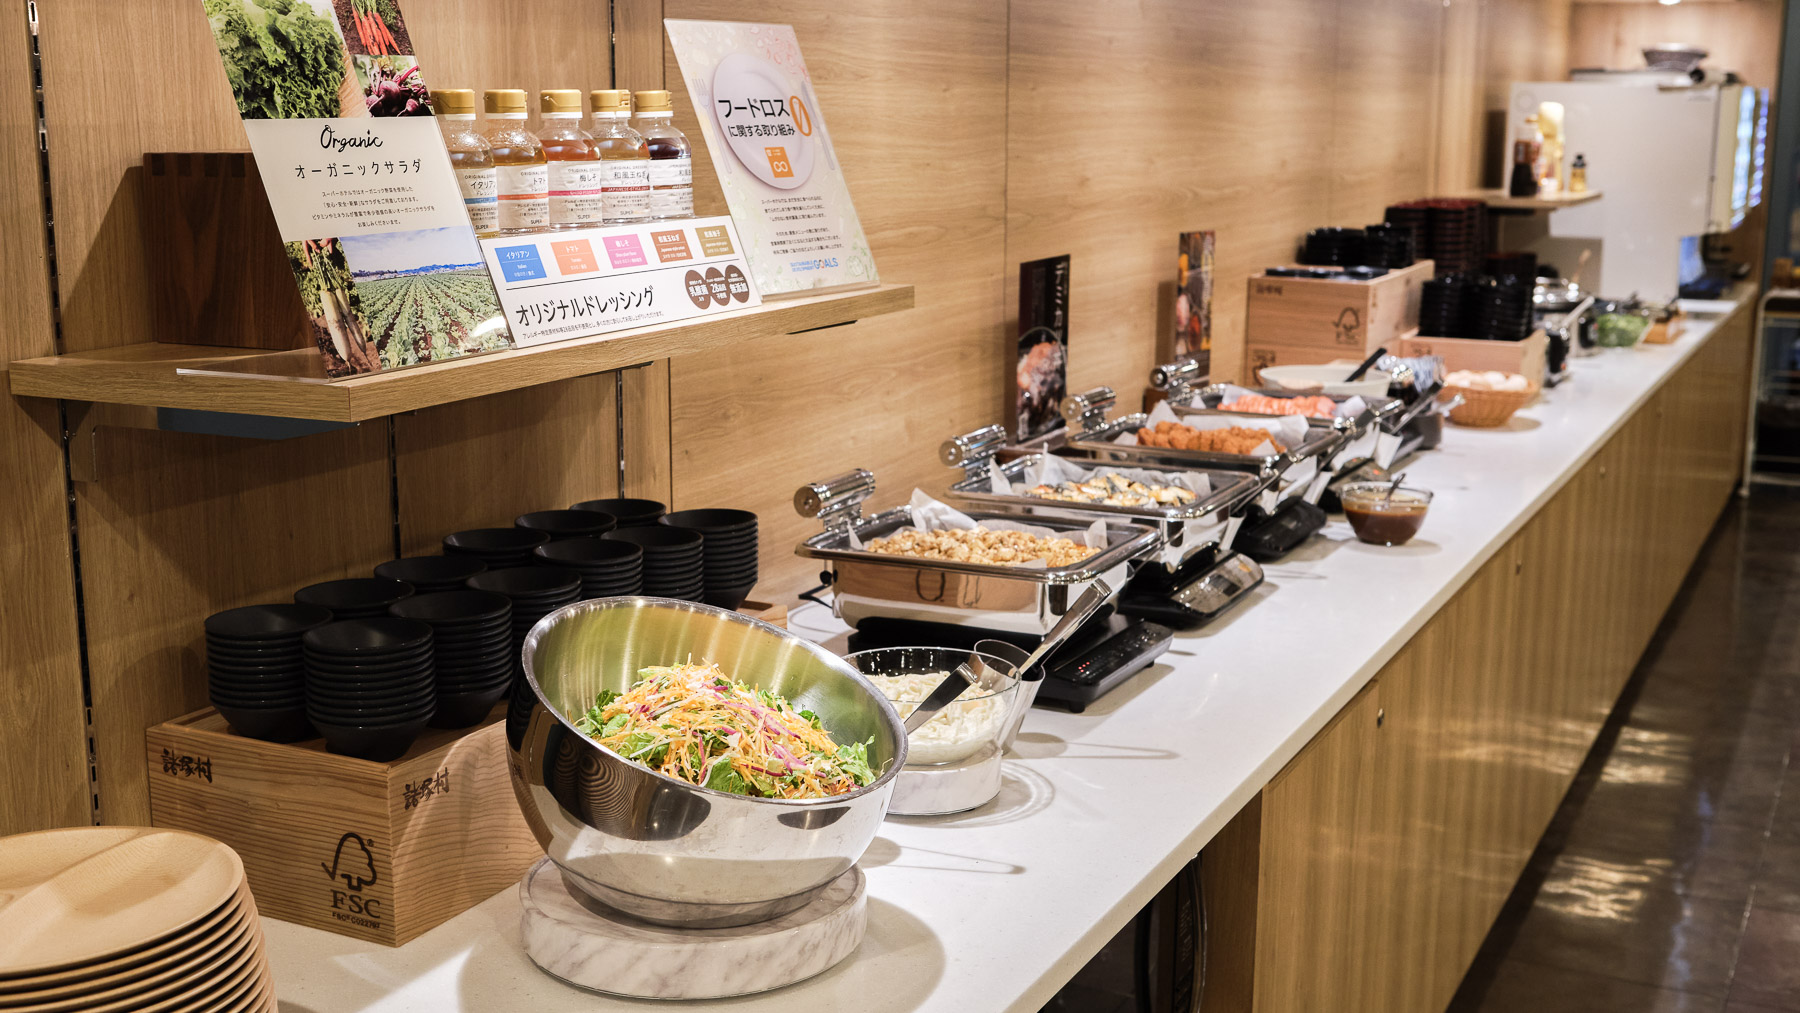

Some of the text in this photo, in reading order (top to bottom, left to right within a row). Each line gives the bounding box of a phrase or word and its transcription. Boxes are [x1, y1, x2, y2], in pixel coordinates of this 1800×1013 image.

[718, 98, 790, 118] フードロス
[728, 124, 796, 137] に関する取り組み
[320, 125, 383, 152] Organic
[295, 159, 421, 179] オーガニックサラダ
[613, 171, 646, 180] 和風玉ねぎ
[471, 181, 496, 191] イタリア
[533, 177, 546, 186] トマト
[506, 250, 530, 260] イタリアン
[565, 245, 579, 254] トマト
[813, 257, 839, 270] GOALS
[516, 284, 654, 326] オリジナルドレッシング
[330, 889, 381, 919] FSC
